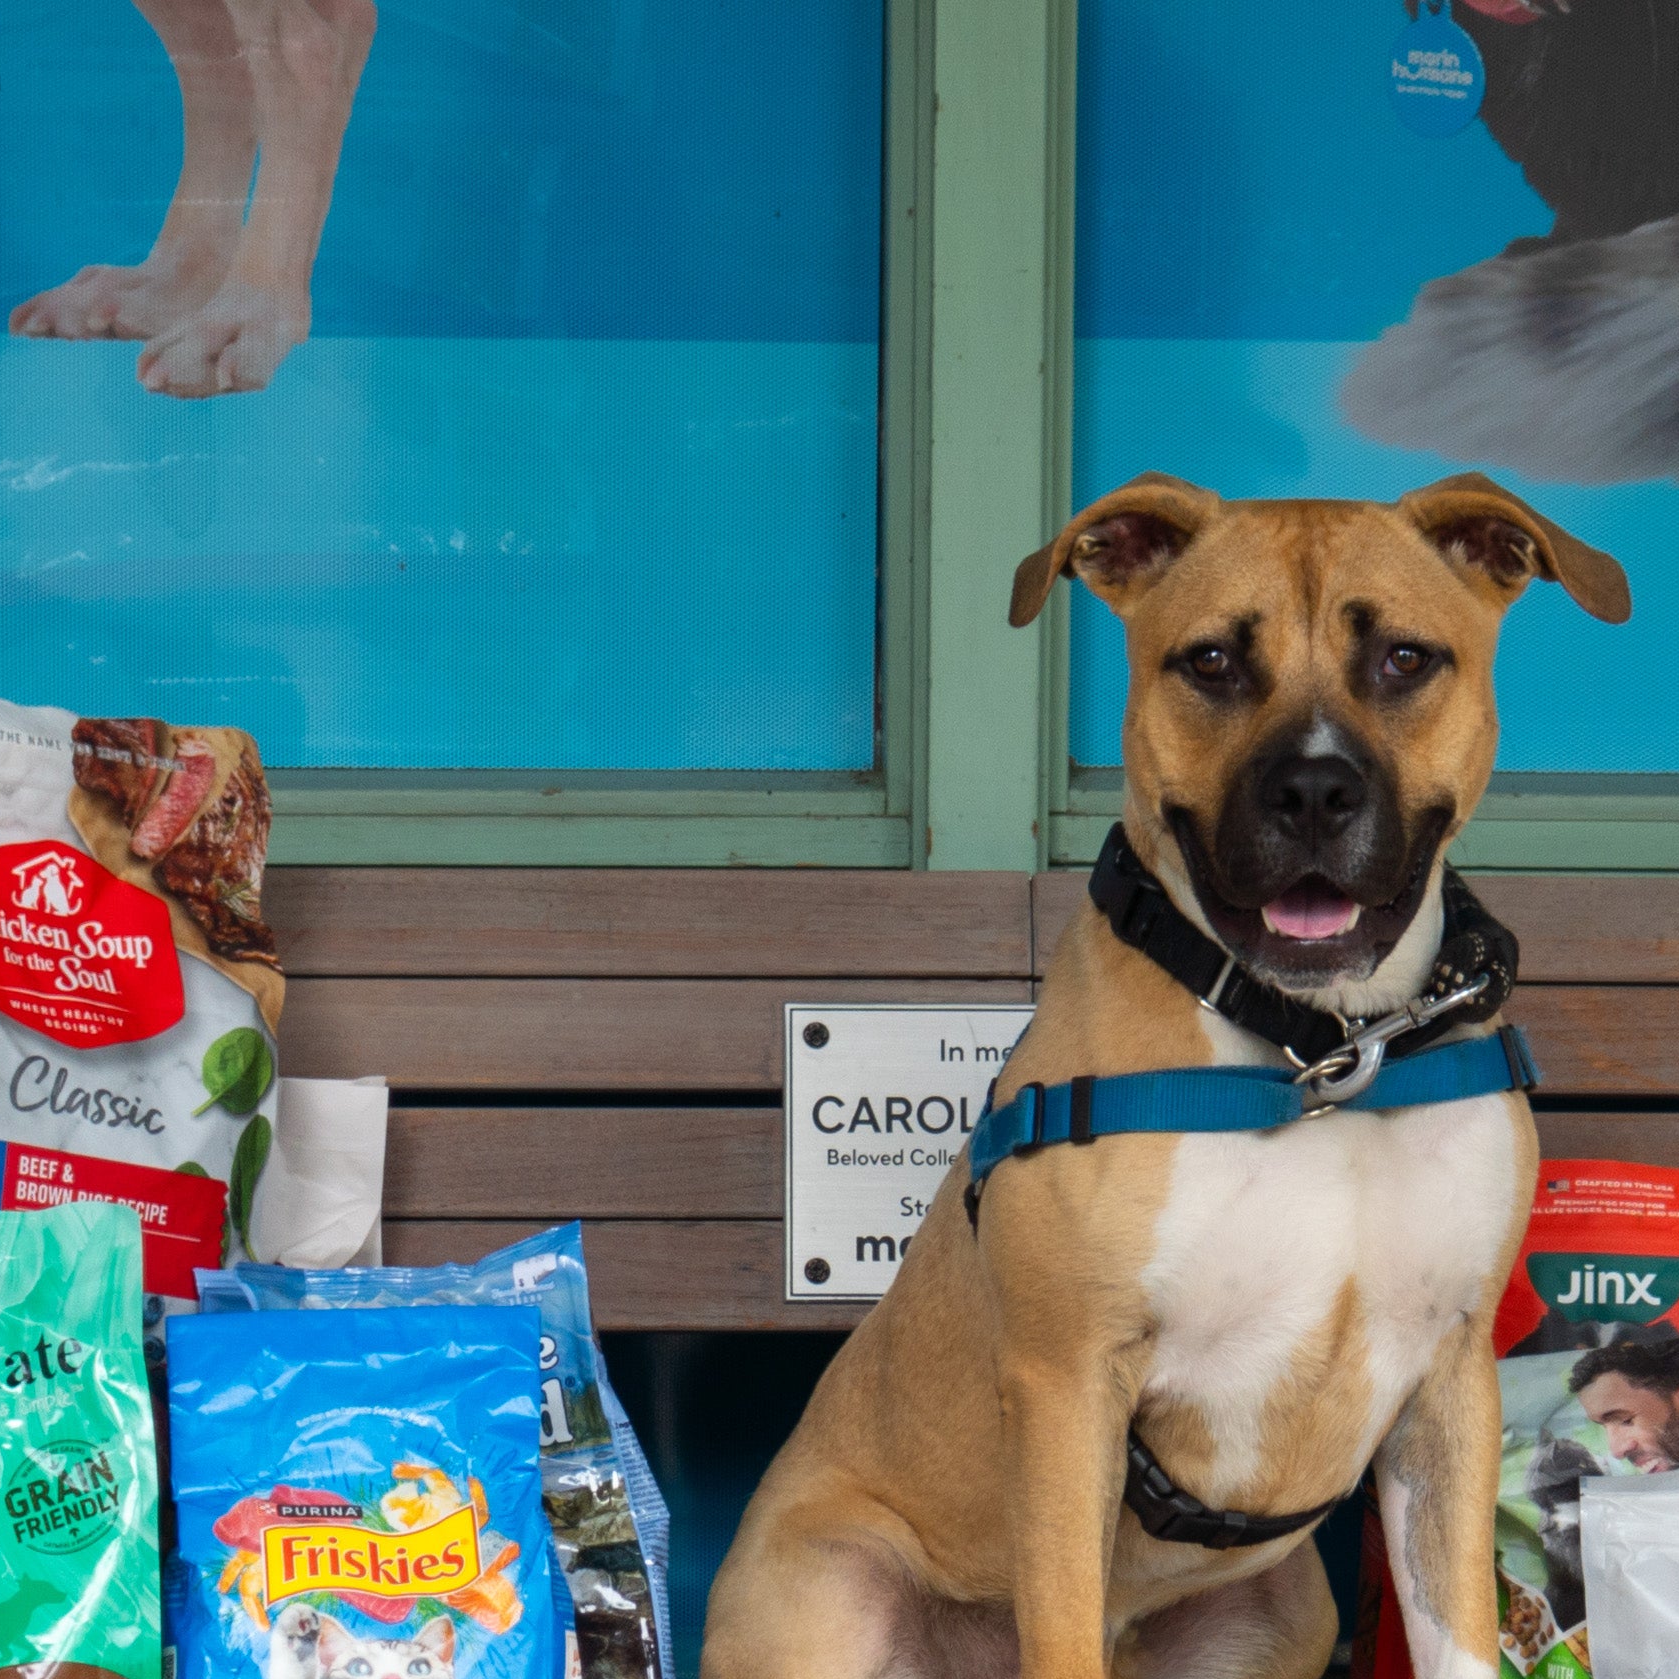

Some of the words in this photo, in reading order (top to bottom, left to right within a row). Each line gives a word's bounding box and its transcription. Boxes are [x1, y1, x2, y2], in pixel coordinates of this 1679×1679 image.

[1392, 59, 1473, 85] humane
[3, 947, 25, 966] for
[27, 954, 54, 972] the
[75, 922, 152, 967] Soup
[55, 956, 117, 994] Soul
[940, 1039, 964, 1062] In
[9, 1054, 168, 1136] Classic
[19, 1155, 58, 1179] BEEF
[62, 1163, 74, 1183] &
[827, 1149, 904, 1166] Beloved
[4, 1451, 115, 1519] GRAIN
[12, 1485, 119, 1544] FRIENDLY
[281, 1506, 358, 1516] PURINA
[282, 1536, 465, 1585] Friskies
